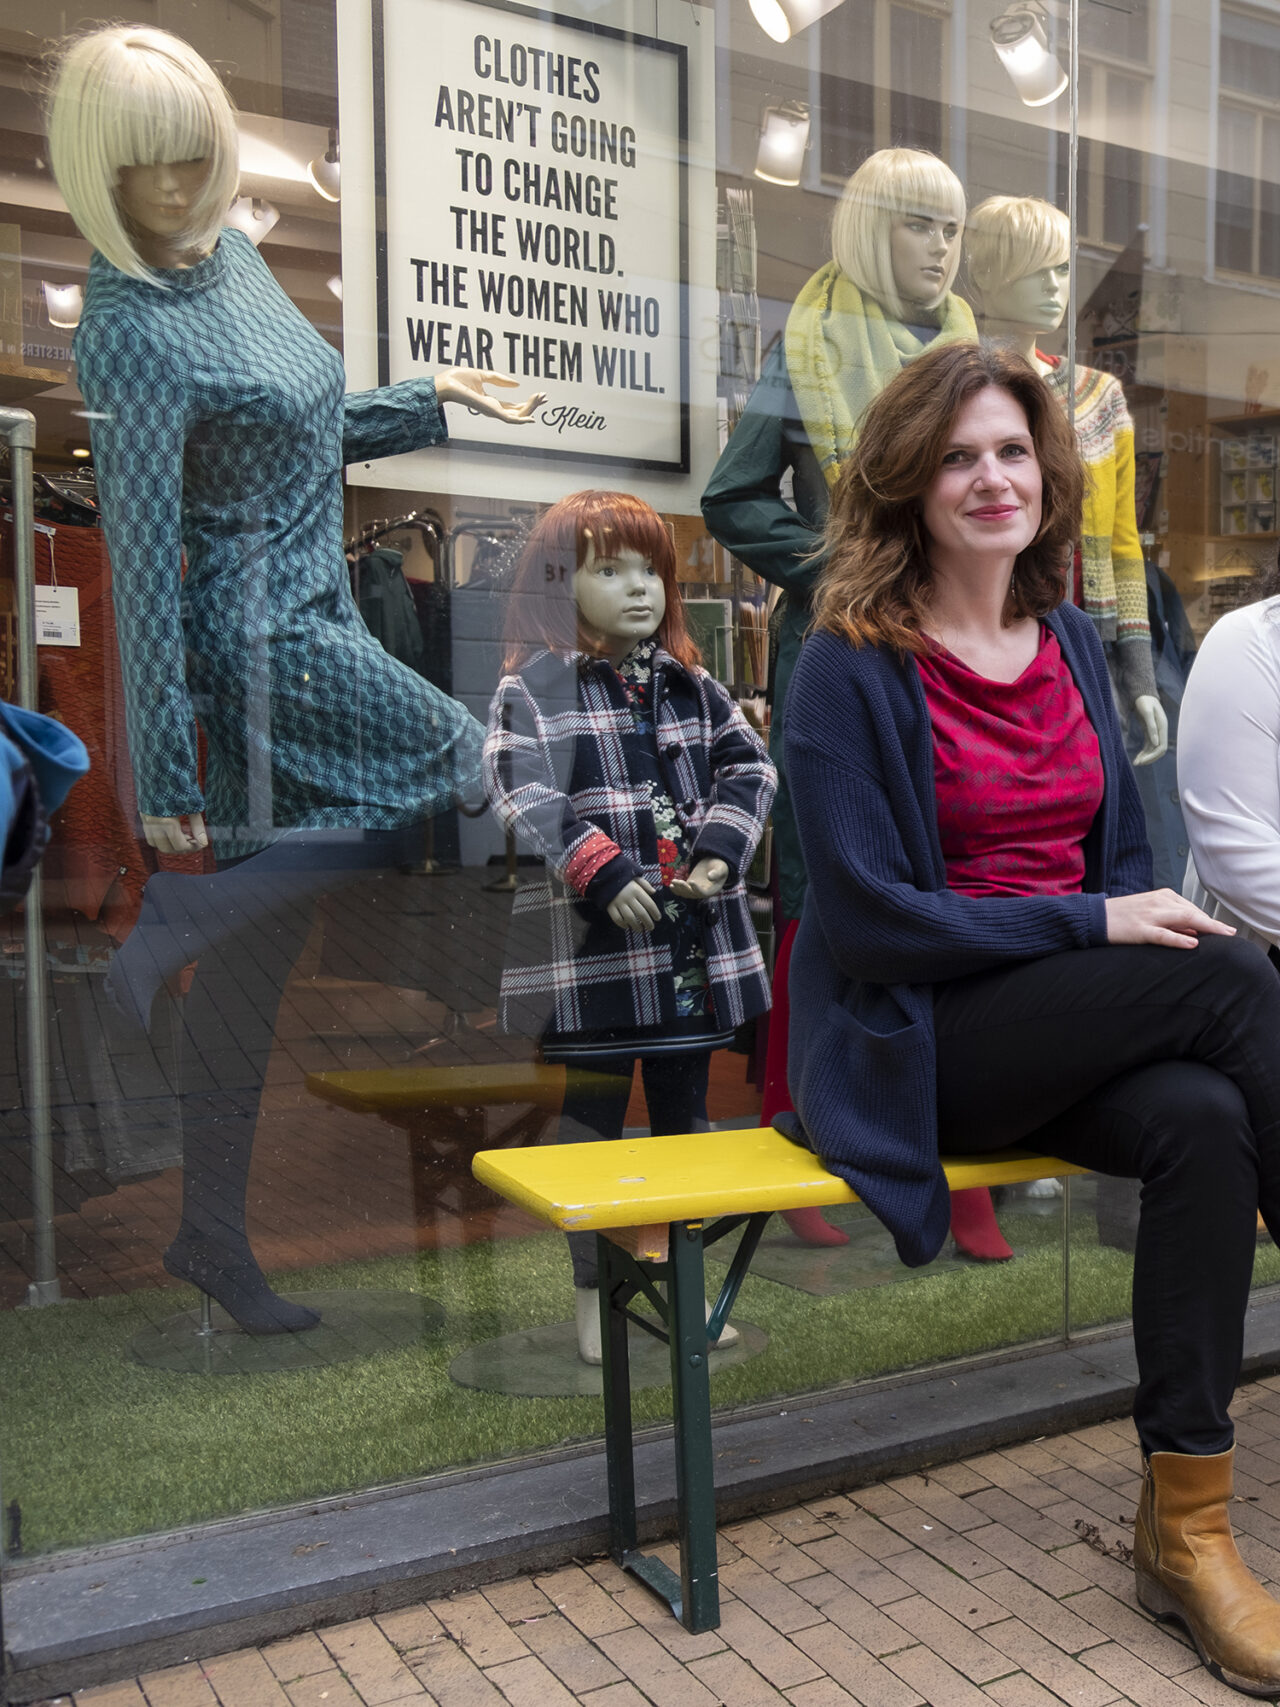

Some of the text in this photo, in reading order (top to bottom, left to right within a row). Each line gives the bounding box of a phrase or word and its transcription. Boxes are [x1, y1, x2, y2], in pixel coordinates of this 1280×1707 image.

[474, 34, 600, 104] CLOTHES
[434, 85, 636, 168] AREN'T GOING
[455, 147, 618, 221] TO CHANGE
[450, 205, 623, 277] THE WORLD.
[410, 258, 660, 338] THE WOMEN WHO
[406, 316, 665, 394] WEAR THEM WILL.
[541, 405, 607, 434] Klein
